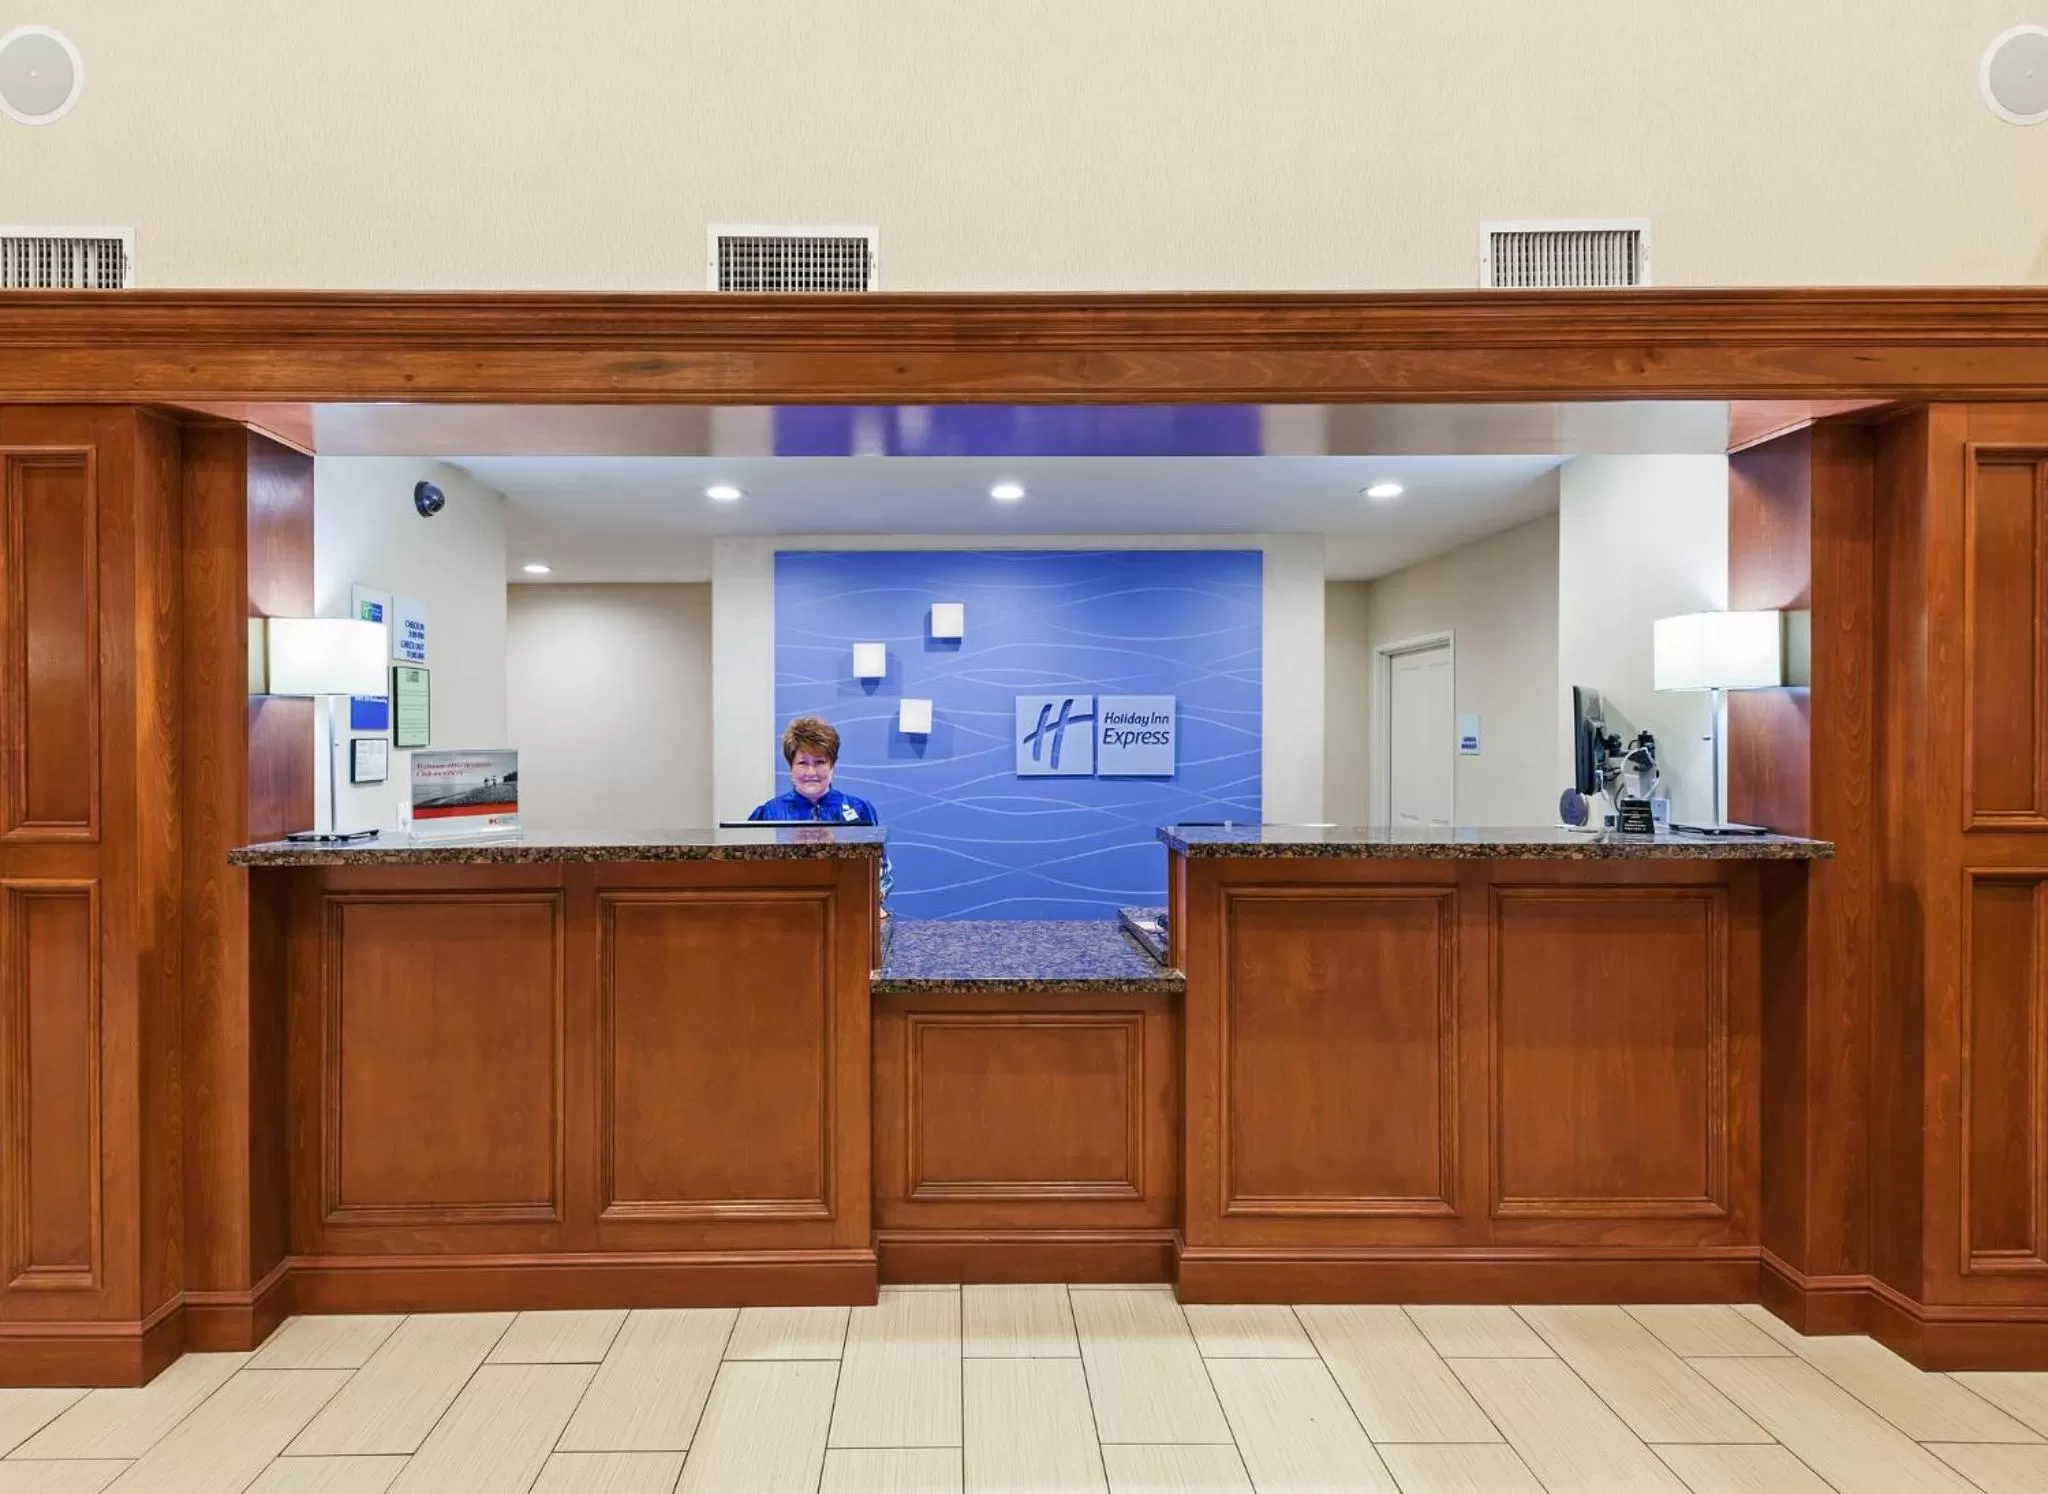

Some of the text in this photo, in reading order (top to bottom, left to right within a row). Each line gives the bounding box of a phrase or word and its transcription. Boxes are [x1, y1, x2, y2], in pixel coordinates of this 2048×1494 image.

[401, 640, 415, 650] CHECK
[1104, 711, 1169, 727] Holiday Inn
[1103, 727, 1170, 749] Express
